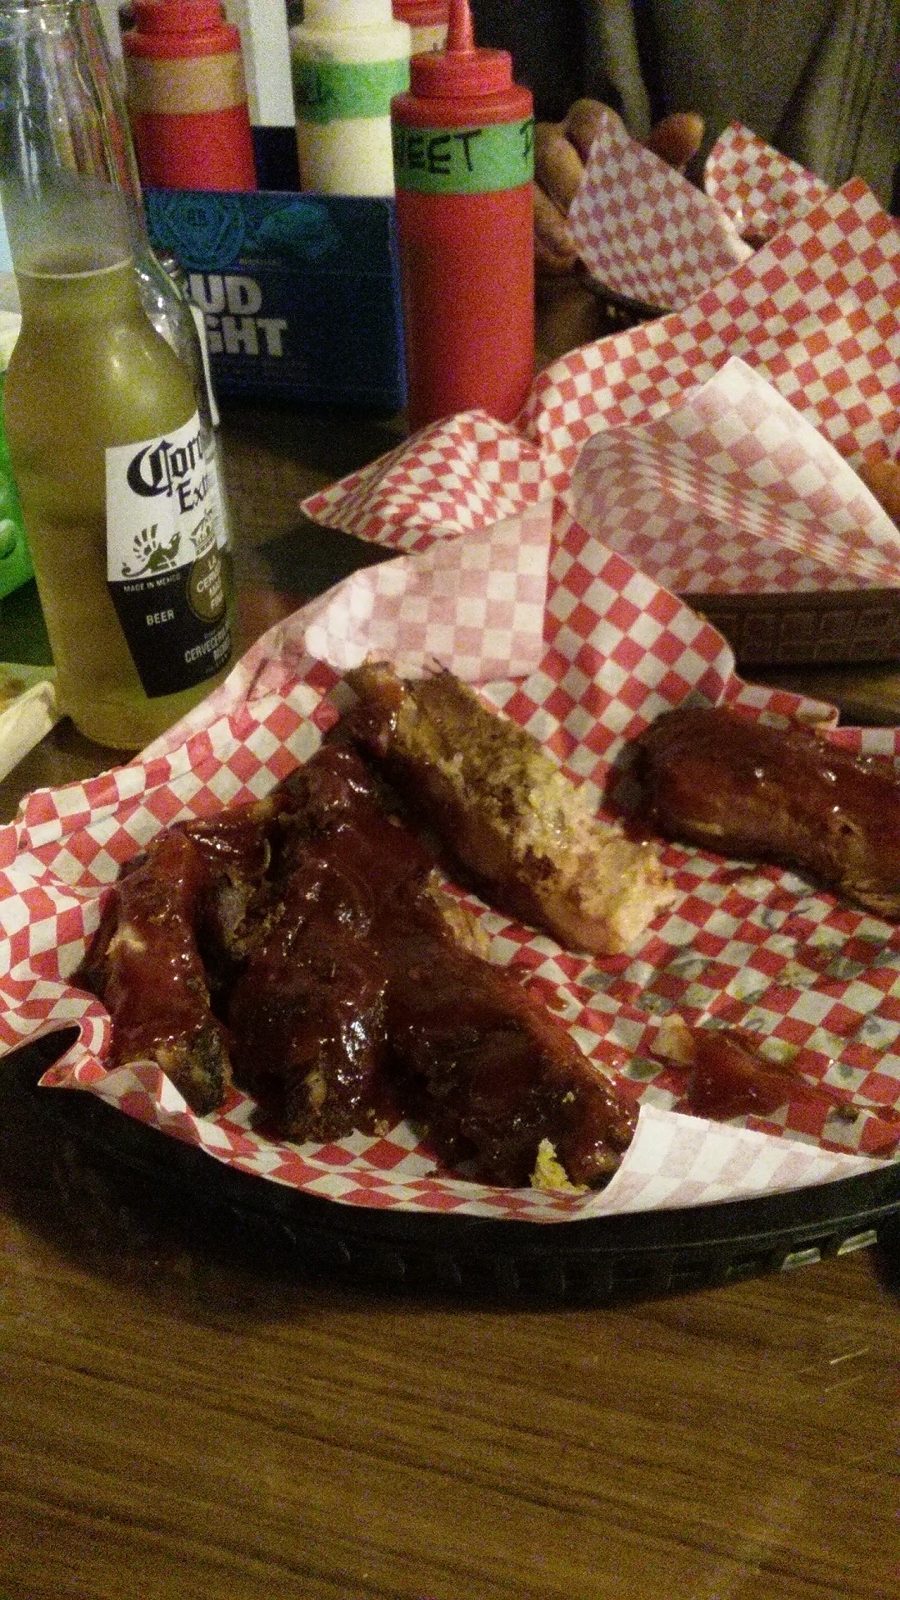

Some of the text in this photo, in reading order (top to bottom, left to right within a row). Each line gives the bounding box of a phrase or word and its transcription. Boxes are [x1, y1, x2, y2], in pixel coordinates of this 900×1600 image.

[403, 129, 482, 174] EET
[126, 431, 203, 497] Cor
[146, 609, 175, 626] BEER
